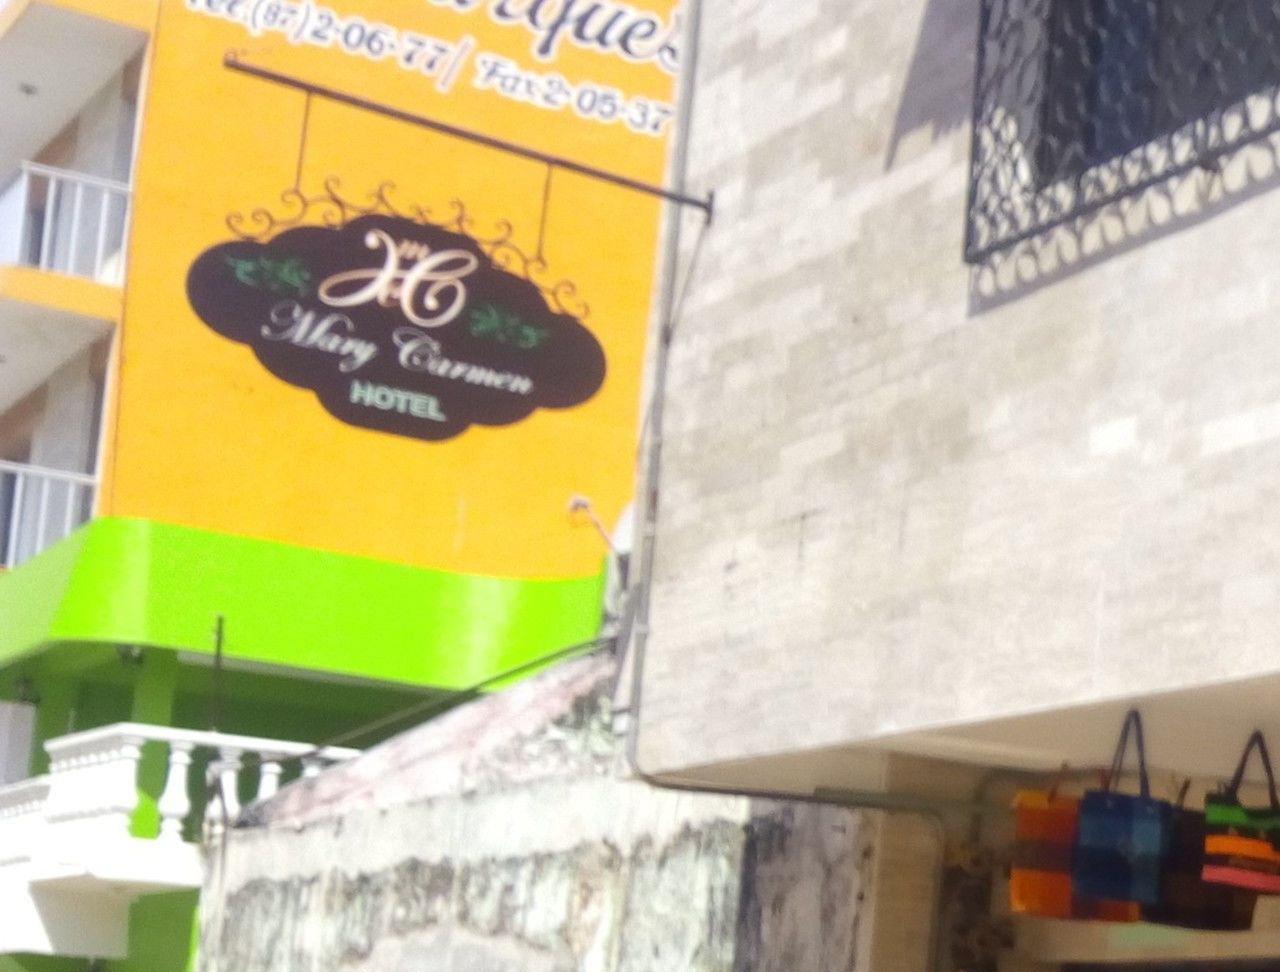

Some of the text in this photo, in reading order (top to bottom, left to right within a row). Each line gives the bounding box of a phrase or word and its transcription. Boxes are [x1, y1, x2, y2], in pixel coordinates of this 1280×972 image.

[261, 300, 534, 395] Mary Carmen
[350, 379, 447, 422] HOTEL
